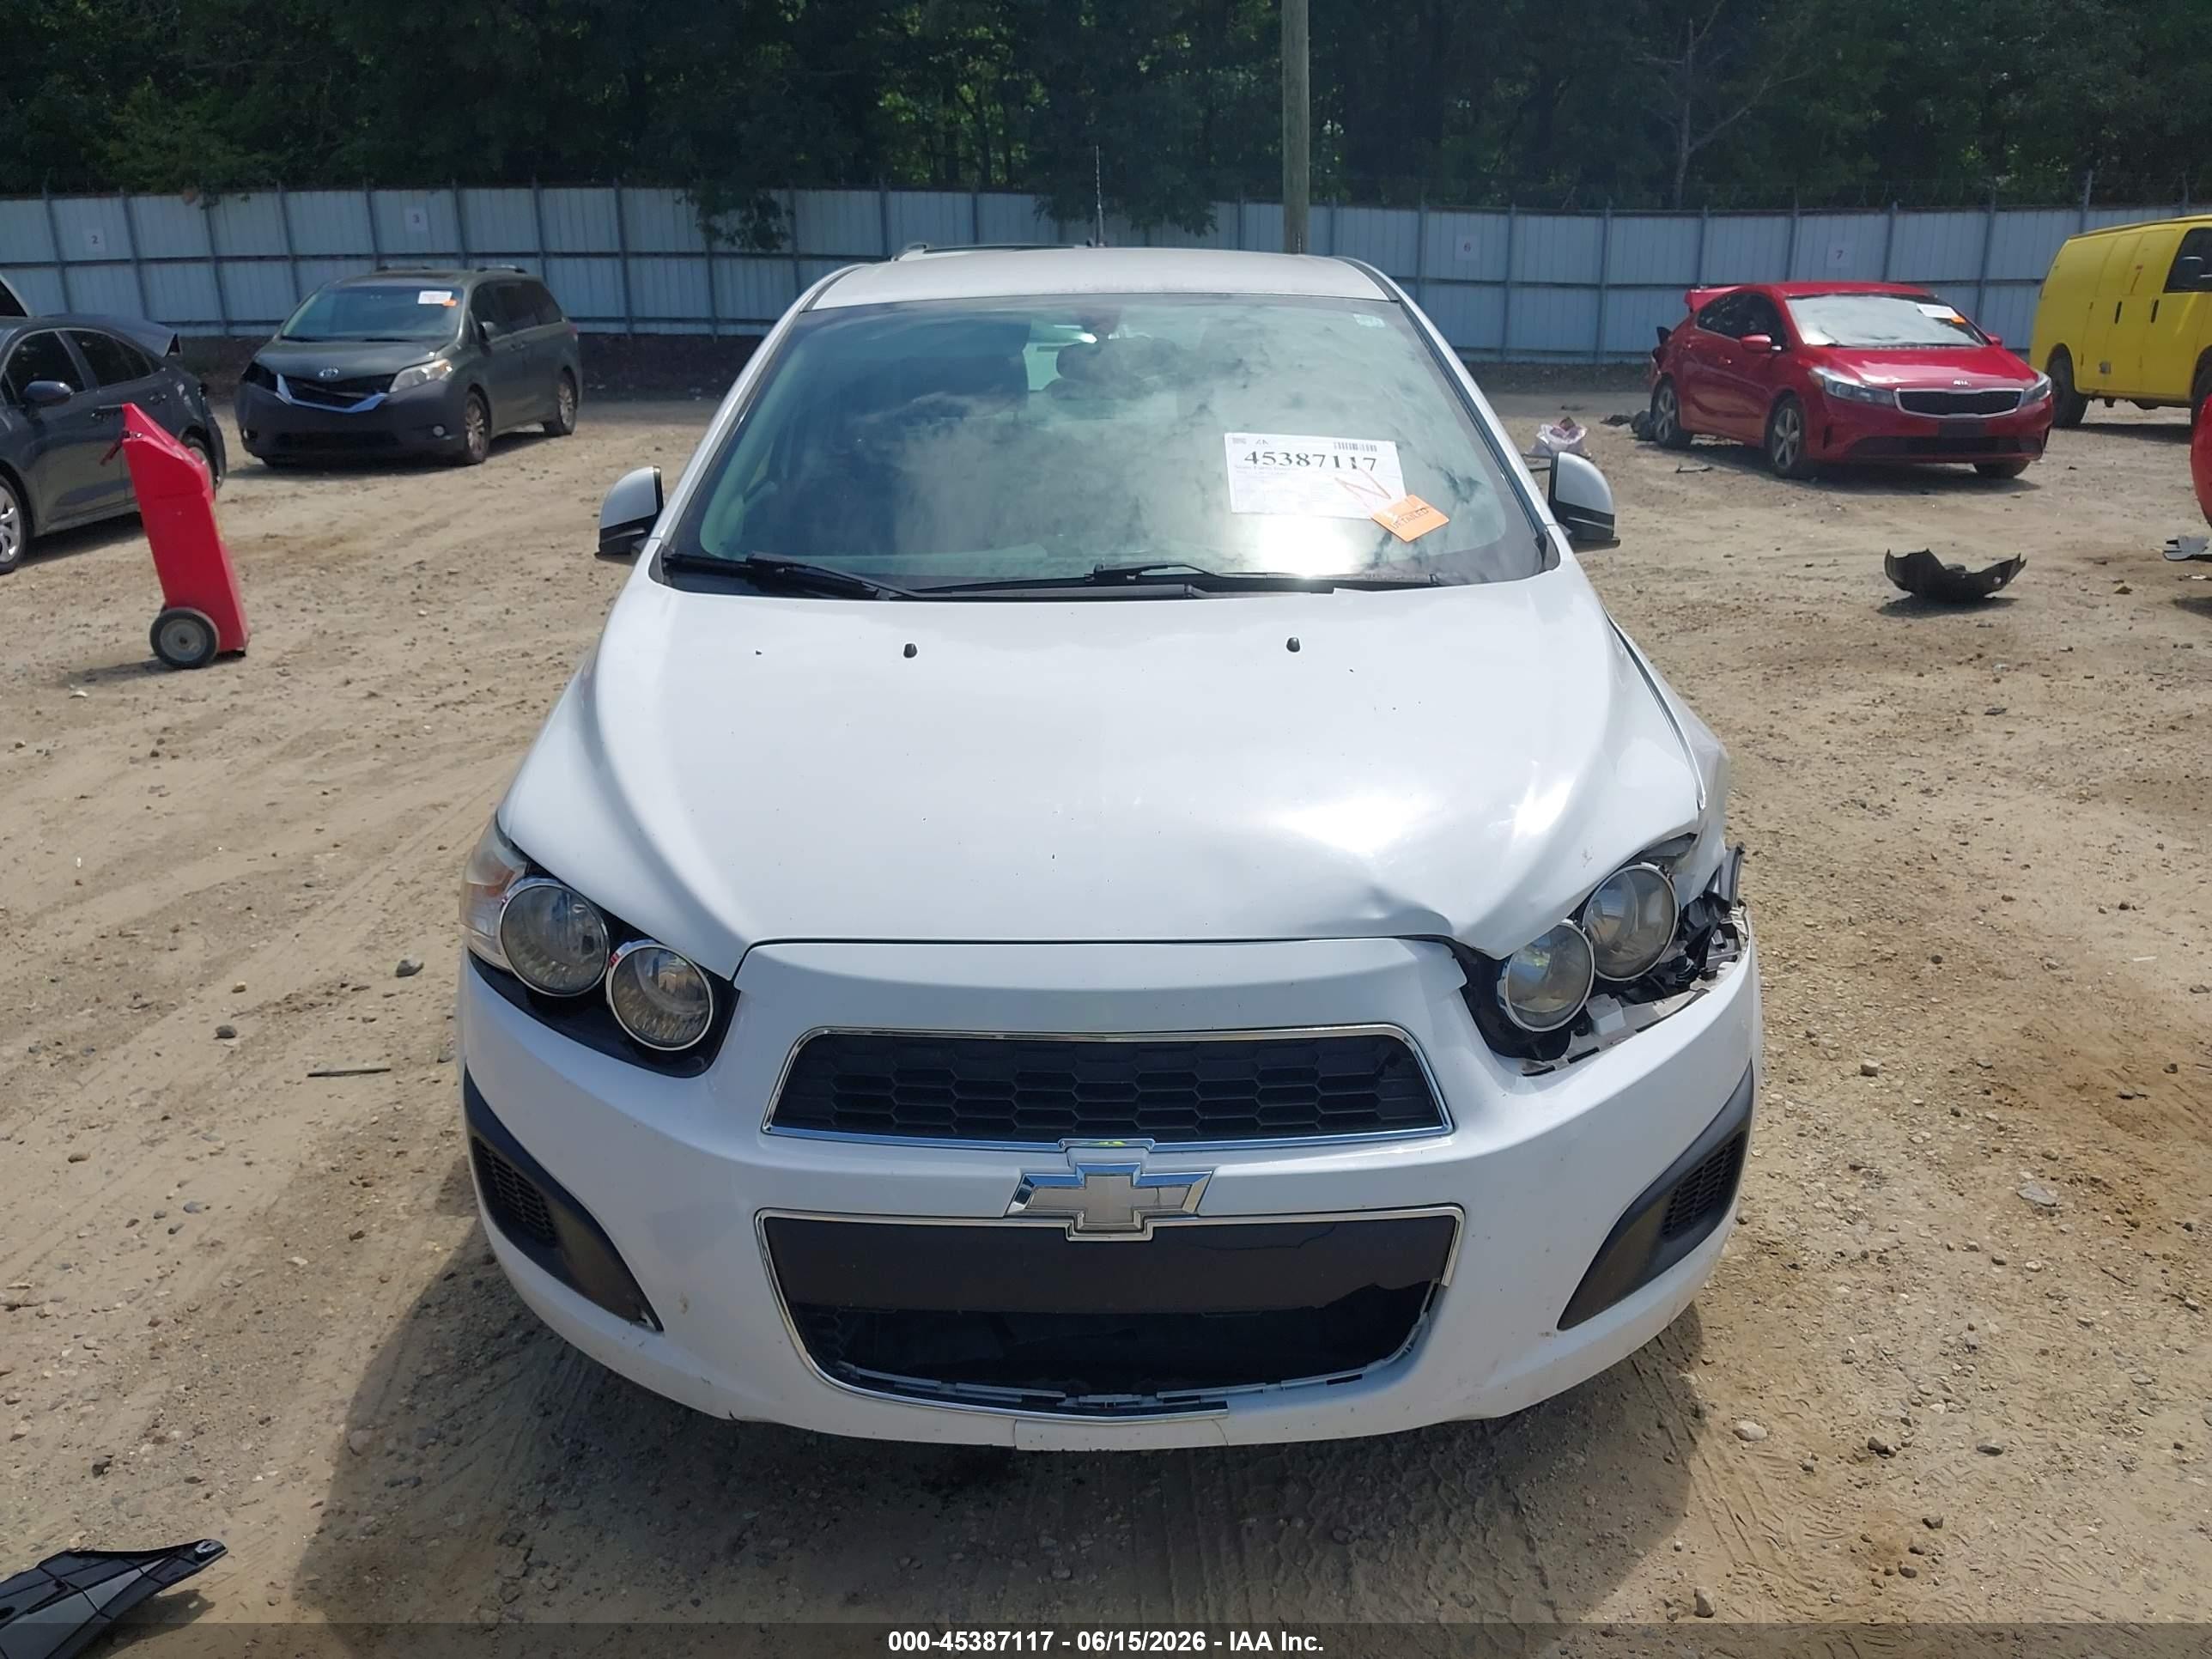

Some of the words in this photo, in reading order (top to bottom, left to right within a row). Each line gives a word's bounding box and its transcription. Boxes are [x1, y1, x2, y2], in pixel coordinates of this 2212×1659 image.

[90, 234, 100, 245] 2
[1836, 250, 1844, 260] 7
[1243, 450, 1378, 472] 45387117
